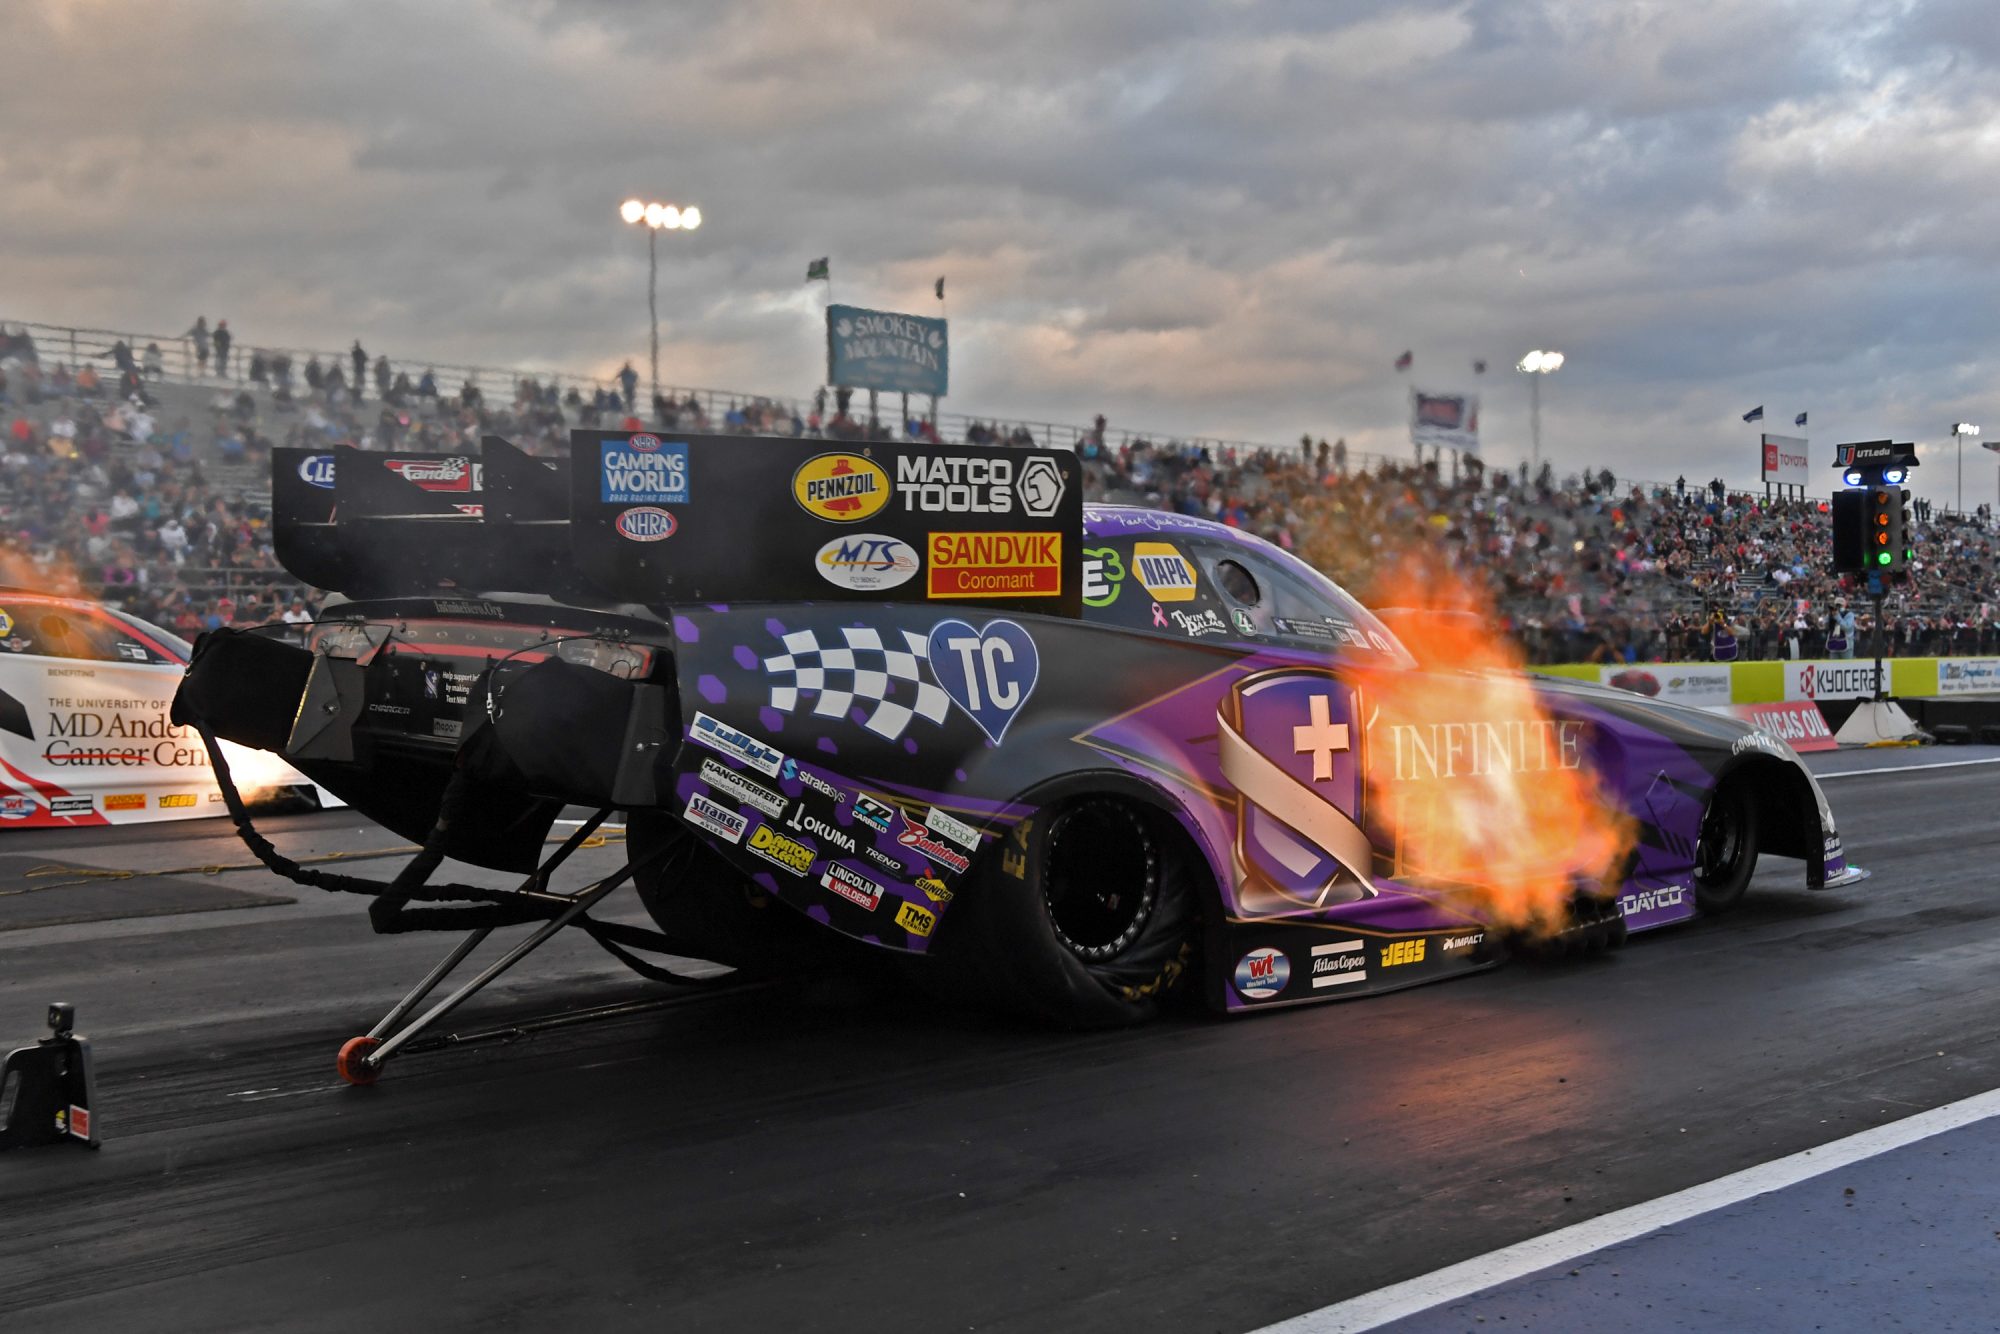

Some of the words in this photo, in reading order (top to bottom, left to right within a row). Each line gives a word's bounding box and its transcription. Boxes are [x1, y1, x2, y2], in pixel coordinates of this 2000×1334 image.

[855, 316, 929, 343] SMOKEY
[844, 336, 938, 370] MOUNTAIN
[605, 451, 684, 471] CAMPING
[1780, 453, 1808, 469] TOYOTA
[1857, 447, 1890, 459] UTI.edu
[606, 469, 684, 492] WORLD
[897, 455, 1012, 485] MATCO
[807, 472, 877, 501] PENNZOIL
[897, 483, 1012, 513] TOOLS
[625, 513, 669, 535] NHRA
[831, 539, 902, 572] MTS
[933, 535, 1057, 565] SANDVIK
[958, 571, 1035, 589] Coromant
[1138, 557, 1192, 586] NAPA
[48, 669, 95, 677] BENEFITING
[948, 636, 1020, 710] TC
[49, 698, 71, 708] THE
[77, 698, 147, 708] UNIVERSITY
[151, 700, 166, 708] OF
[369, 704, 410, 714] CHARGER
[47, 712, 103, 737] MD
[1754, 711, 1805, 739] LUCAS
[1802, 709, 1830, 737] OIL
[45, 740, 149, 766] Cancer
[1390, 720, 1584, 781] INFINITE
[1732, 731, 1785, 755] GOODYEAR
[799, 771, 846, 803] stratasys
[690, 798, 743, 831] Strange
[852, 811, 887, 834] CARRILLO
[700, 821, 724, 835] AXLES
[931, 814, 975, 844] BioPledge
[865, 847, 901, 869] TREND
[829, 863, 873, 894] LINCOLN
[916, 880, 952, 902] SUNOCO
[834, 881, 872, 907] WELDERS
[1617, 886, 1686, 915] DAYCO
[906, 906, 932, 929] TMS
[1381, 939, 1426, 967] JEGS
[1454, 934, 1484, 948] IMPACT
[1311, 958, 1339, 973] Atlas
[1339, 955, 1365, 971] Copco
